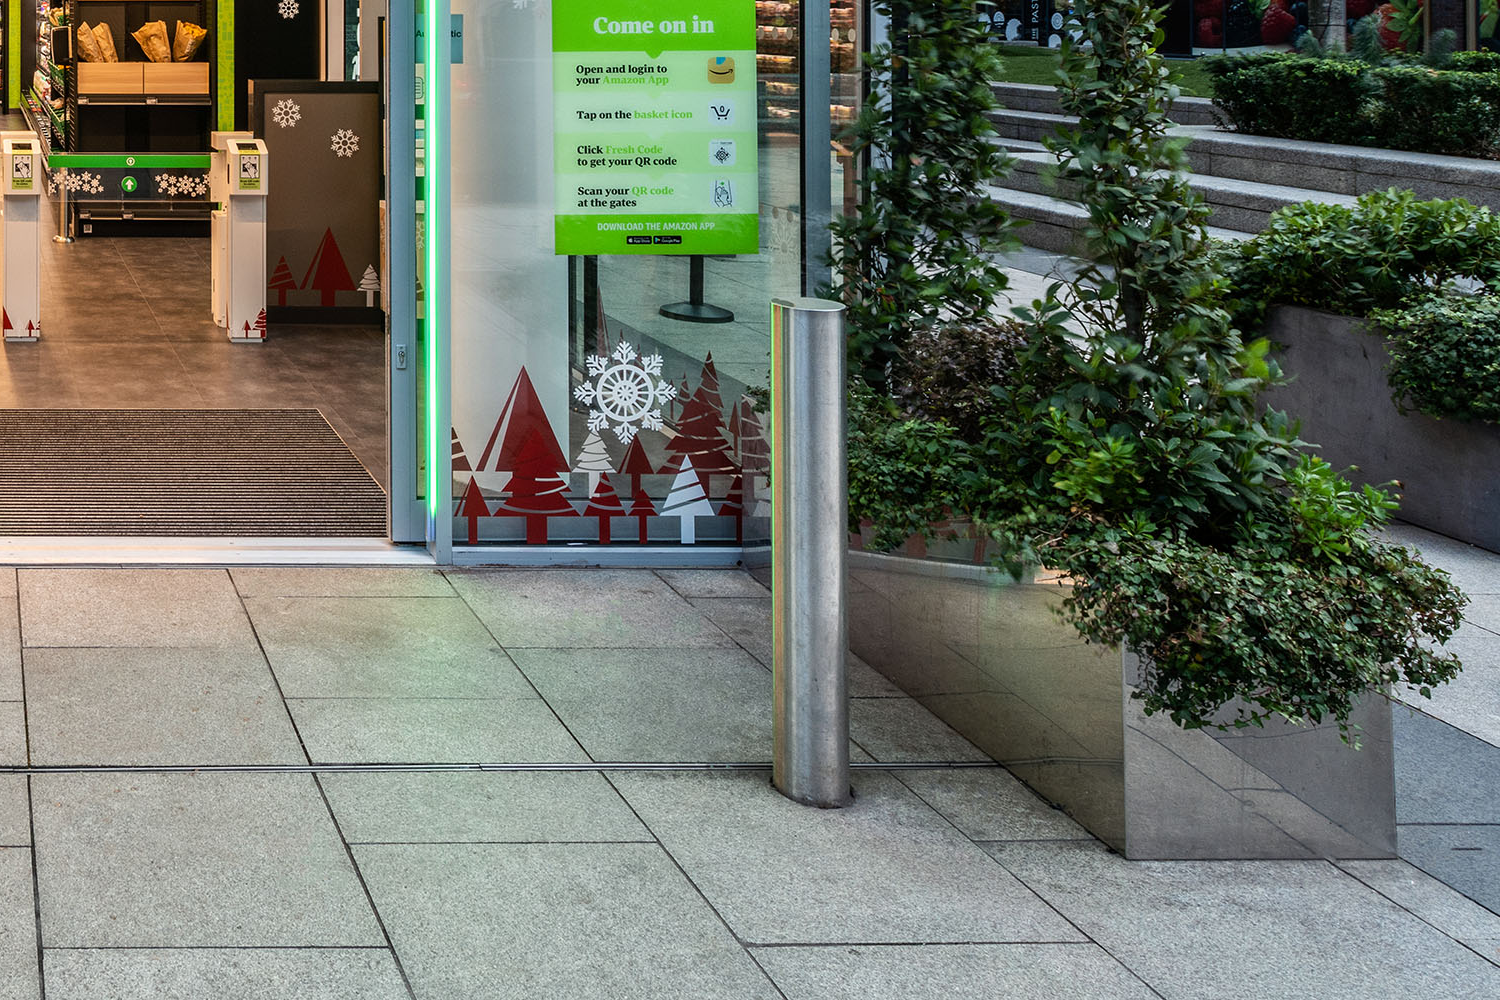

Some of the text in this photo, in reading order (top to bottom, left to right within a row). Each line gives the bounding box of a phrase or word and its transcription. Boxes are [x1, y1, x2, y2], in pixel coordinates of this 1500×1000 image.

[593, 15, 715, 34] Come on in
[576, 64, 668, 75] Open and login to
[576, 75, 669, 86] your Amazon App
[576, 110, 597, 121] Tap
[614, 110, 632, 119] the
[634, 110, 669, 119] basket
[671, 109, 693, 119] icon
[577, 145, 663, 154] Click Fresh Code
[577, 156, 677, 168] to get your QR code
[577, 186, 674, 197] Scan your QR code
[577, 198, 637, 209] at the gates
[597, 222, 715, 231] DOWNLOAD THE AMAZON APP
